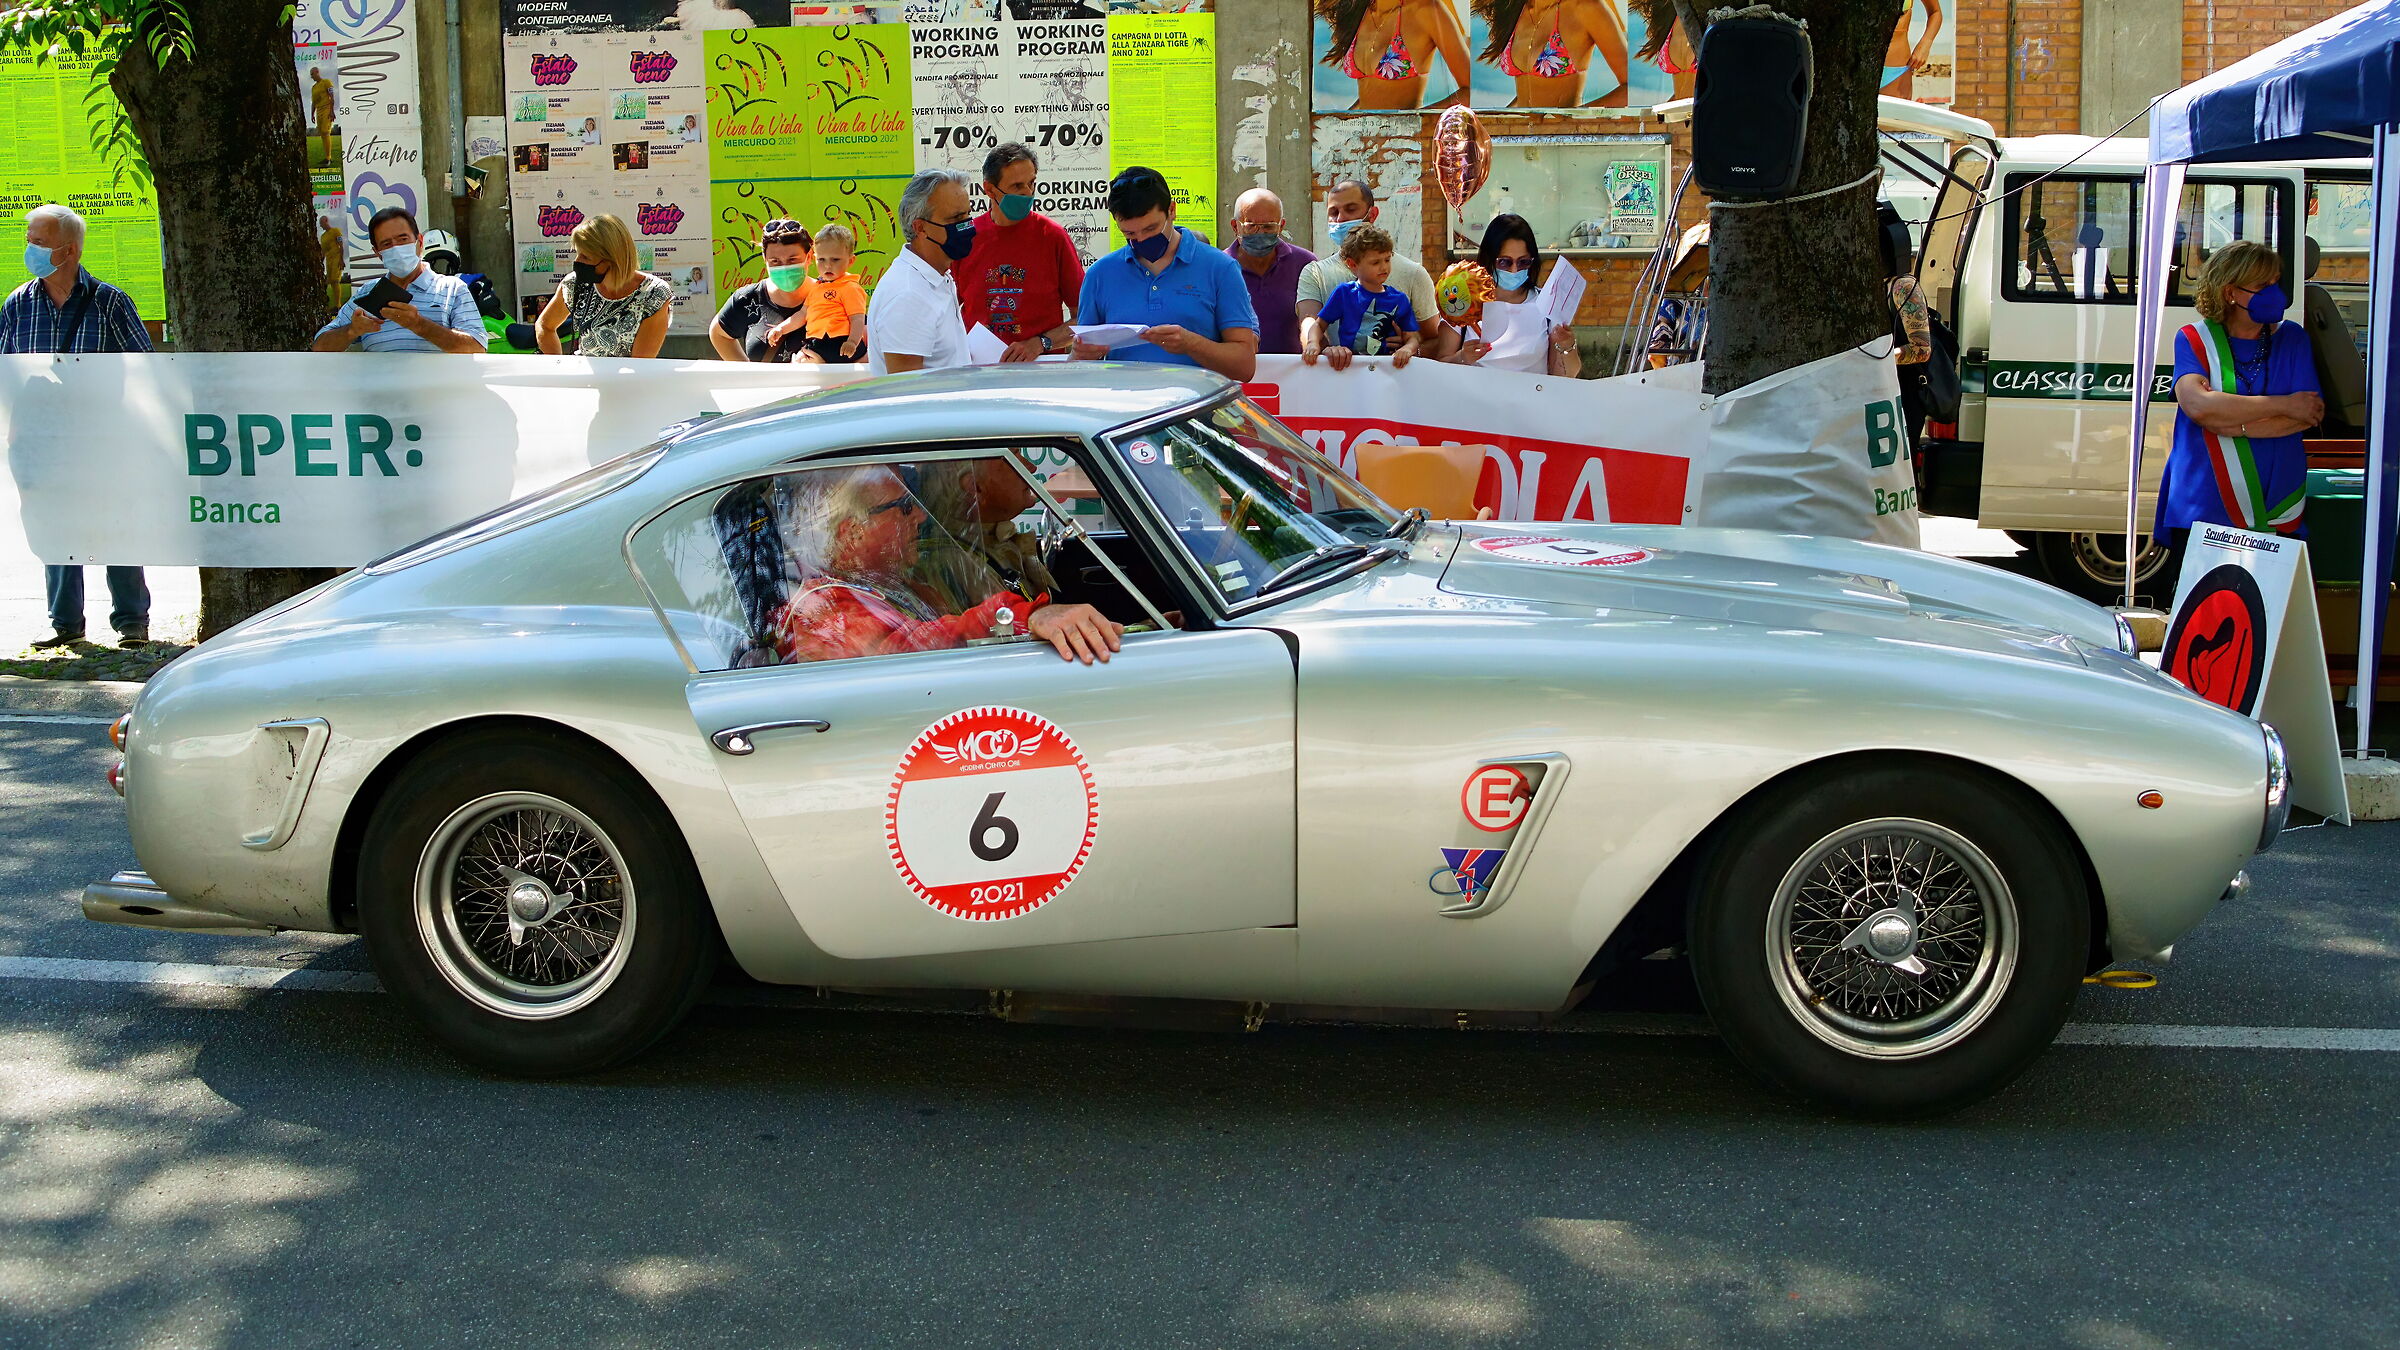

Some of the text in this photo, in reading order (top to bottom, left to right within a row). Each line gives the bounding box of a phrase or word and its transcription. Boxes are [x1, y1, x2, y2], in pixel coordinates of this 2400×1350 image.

[517, 1, 568, 12] MODERN
[517, 14, 613, 25] CONTEMPORANEA
[912, 27, 999, 43] WORKING
[1016, 24, 1105, 39] WORKING
[1112, 32, 1151, 40] CAMPAGNA
[1164, 31, 1187, 39] LOTTA
[913, 43, 999, 59] PROGRAM
[1018, 41, 1105, 56] PROGRAM
[1112, 39, 1189, 49] ALLA ZANZARA TIGRE
[631, 52, 677, 70] Estate
[1112, 49, 1133, 57] ANNO
[532, 55, 577, 73] Estate
[535, 68, 571, 85] bene
[635, 66, 670, 82] bene
[944, 73, 999, 81] PROMOZIONALE
[1049, 71, 1105, 79] PROMOZIONALE
[936, 107, 963, 115] THING
[966, 106, 989, 114] MUST
[991, 105, 1004, 113] GO
[1014, 105, 1038, 114] EVERY
[1070, 104, 1094, 112] MUST
[1096, 103, 1110, 111] GO
[715, 113, 803, 138] Viva la Vida
[816, 110, 905, 134] Viva la Vida
[724, 137, 797, 147] MERCURDO 2021
[825, 134, 899, 144] MERCURDO 2021
[921, 126, 998, 148] -70%
[1025, 124, 1103, 146] -70%
[1617, 171, 1653, 182] ORFEI
[68, 192, 102, 200] CAMPAGNA
[1034, 181, 1108, 196] ORKING
[1171, 188, 1189, 196] OTTA
[1033, 196, 1108, 212] ROGRAM
[538, 206, 583, 224] Estate
[638, 203, 684, 222] Estate
[642, 218, 678, 235] bene
[1992, 370, 2173, 395] CLASSIC CLB
[184, 413, 424, 477] BPER:
[1140, 448, 1149, 458] 6
[189, 495, 281, 524] Banca
[1480, 778, 1512, 818] E
[969, 791, 1019, 862] 6
[970, 882, 1024, 905] 2021
